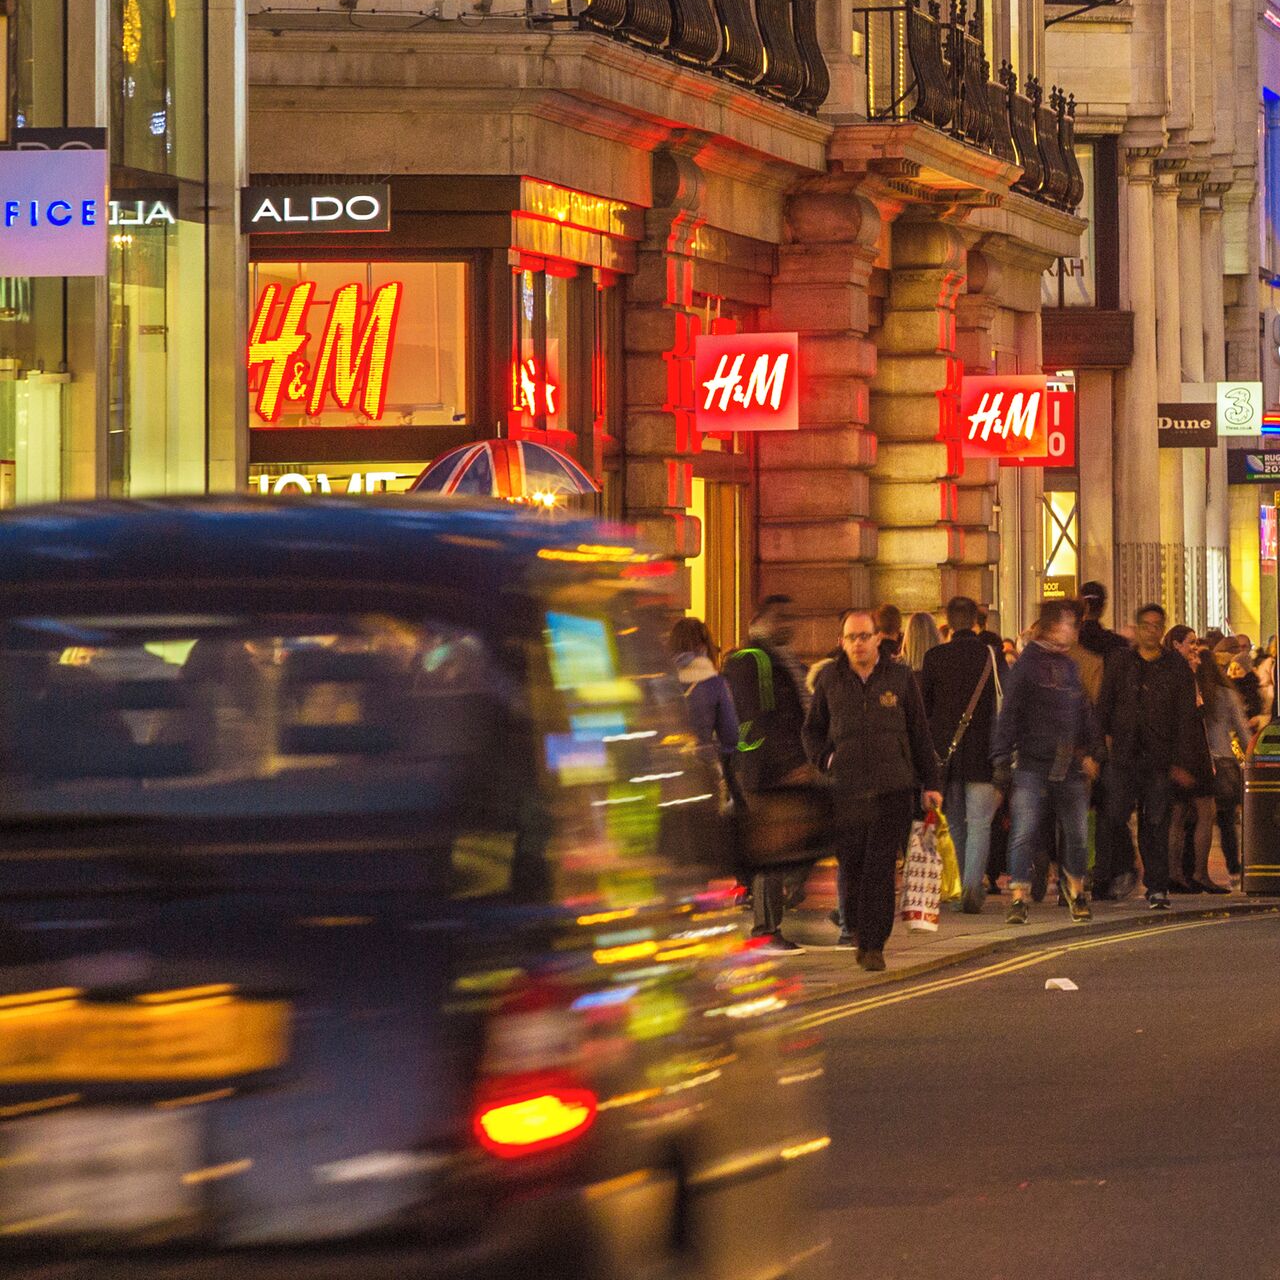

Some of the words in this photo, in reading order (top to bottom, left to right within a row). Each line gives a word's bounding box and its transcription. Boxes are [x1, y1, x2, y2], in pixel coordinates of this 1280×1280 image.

[252, 195, 380, 222] ALDO
[248, 282, 402, 421] H&M
[702, 353, 789, 411] H&M
[967, 391, 1041, 442] H&M
[1158, 417, 1212, 430] Dune
[1224, 387, 1255, 425] 3
